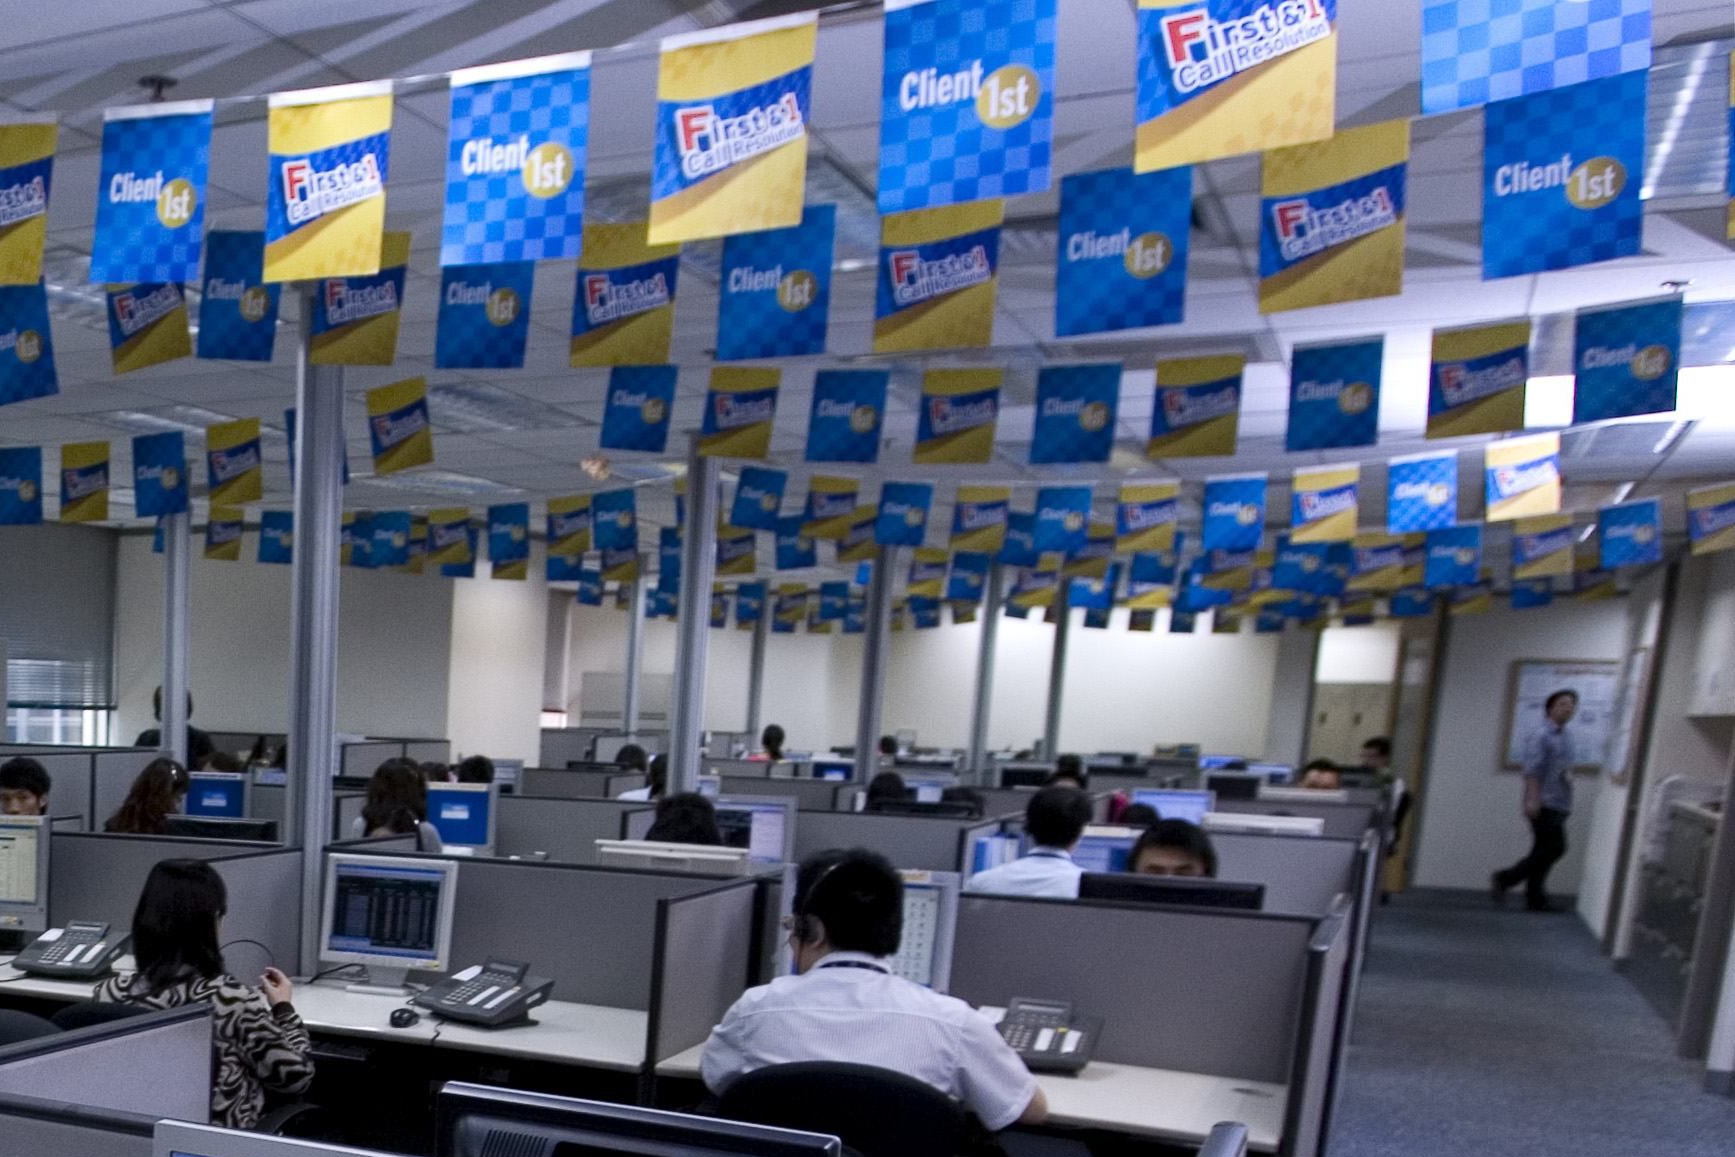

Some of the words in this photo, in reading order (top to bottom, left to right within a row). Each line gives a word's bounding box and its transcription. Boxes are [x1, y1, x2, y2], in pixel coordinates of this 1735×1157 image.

[1179, 51, 1228, 88] Call
[1238, 23, 1326, 65] Resolution
[900, 60, 982, 112] Client
[989, 80, 1030, 119] 1st
[461, 134, 528, 176] Client
[531, 151, 565, 188] 1st
[688, 143, 728, 173] Call
[734, 122, 803, 153] Resolution
[110, 171, 163, 203] Client
[164, 187, 190, 220] 1st
[1495, 153, 1572, 197] Client
[1575, 167, 1616, 202] 1st
[1068, 228, 1129, 262] Client
[1132, 241, 1166, 272] 1st
[447, 281, 491, 305] Client
[492, 297, 514, 319] 1st
[728, 263, 782, 292] Client
[783, 276, 811, 306] 1st
[900, 281, 930, 301] Call
